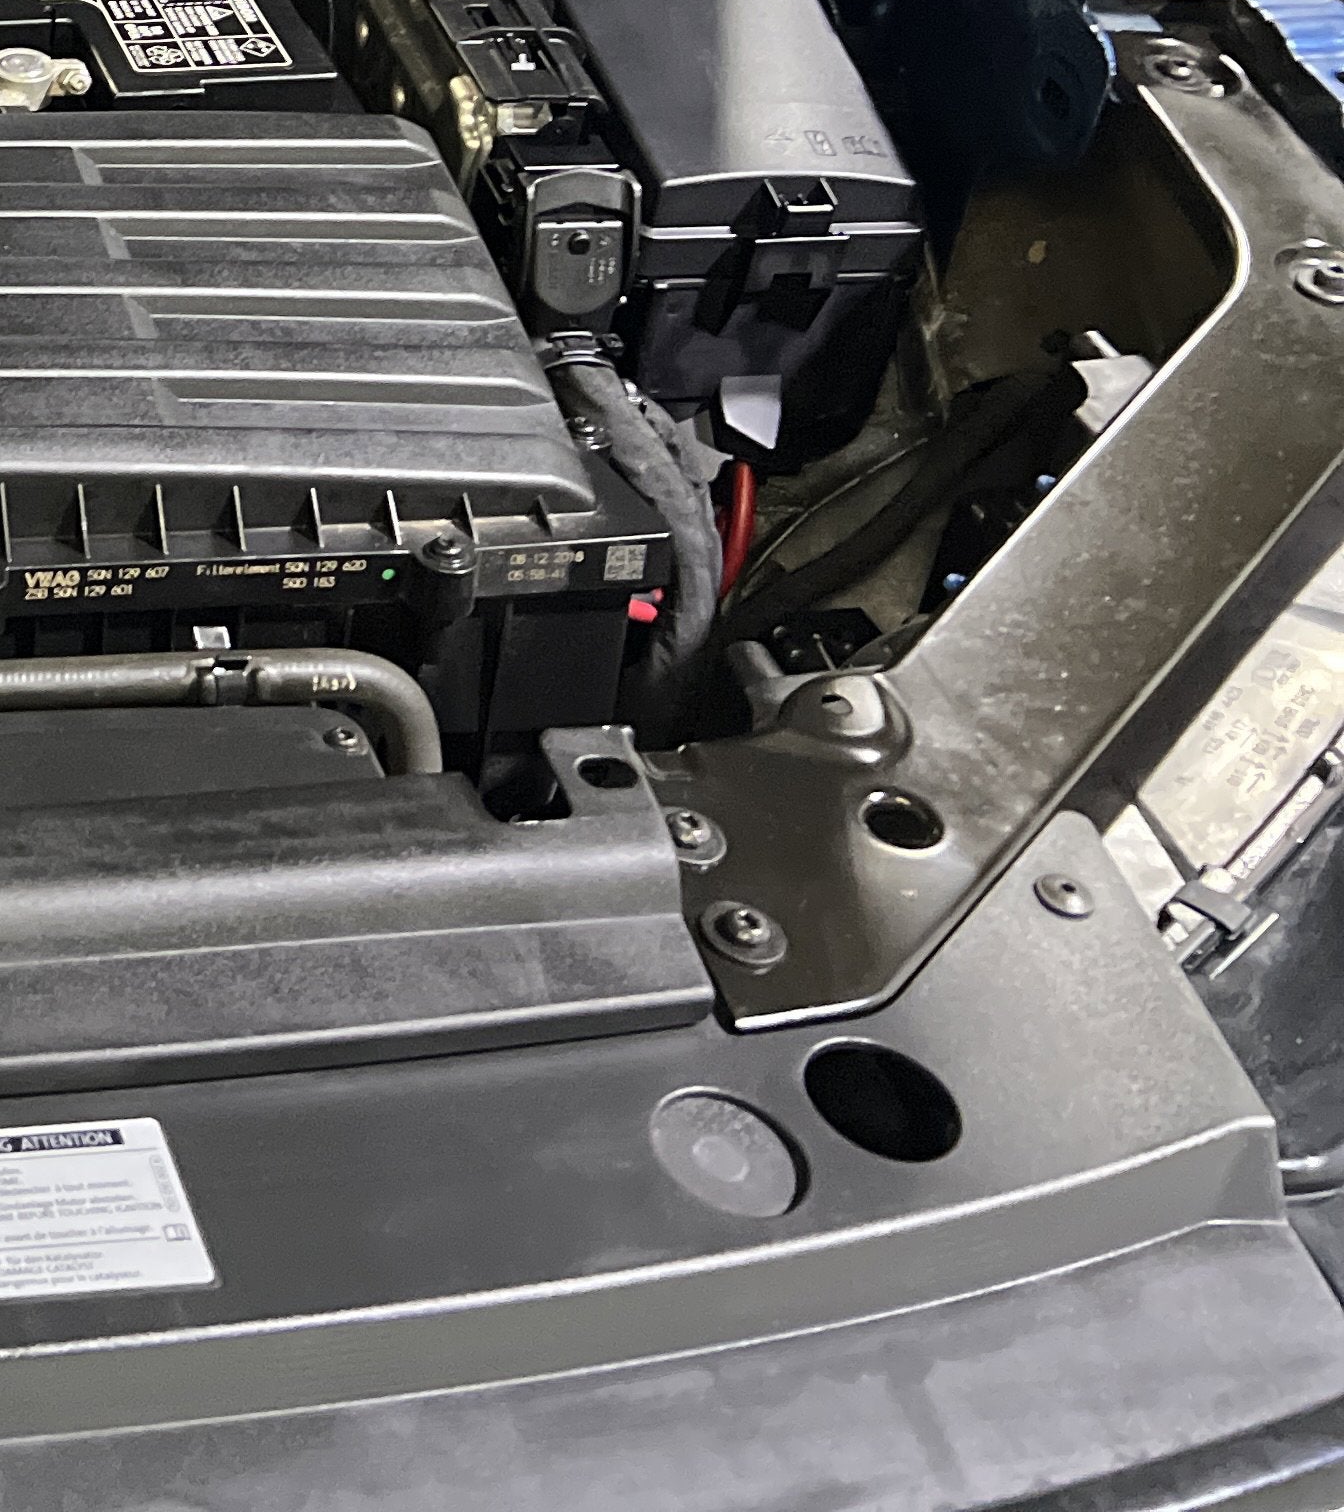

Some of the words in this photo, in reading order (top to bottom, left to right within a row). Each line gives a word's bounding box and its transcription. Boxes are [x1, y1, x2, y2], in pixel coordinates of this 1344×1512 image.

[118, 567, 141, 579] 129
[196, 563, 281, 576] Filterelement
[316, 560, 339, 572] 129
[84, 585, 107, 597] 129
[19, 1130, 113, 1152] ATTENTION
